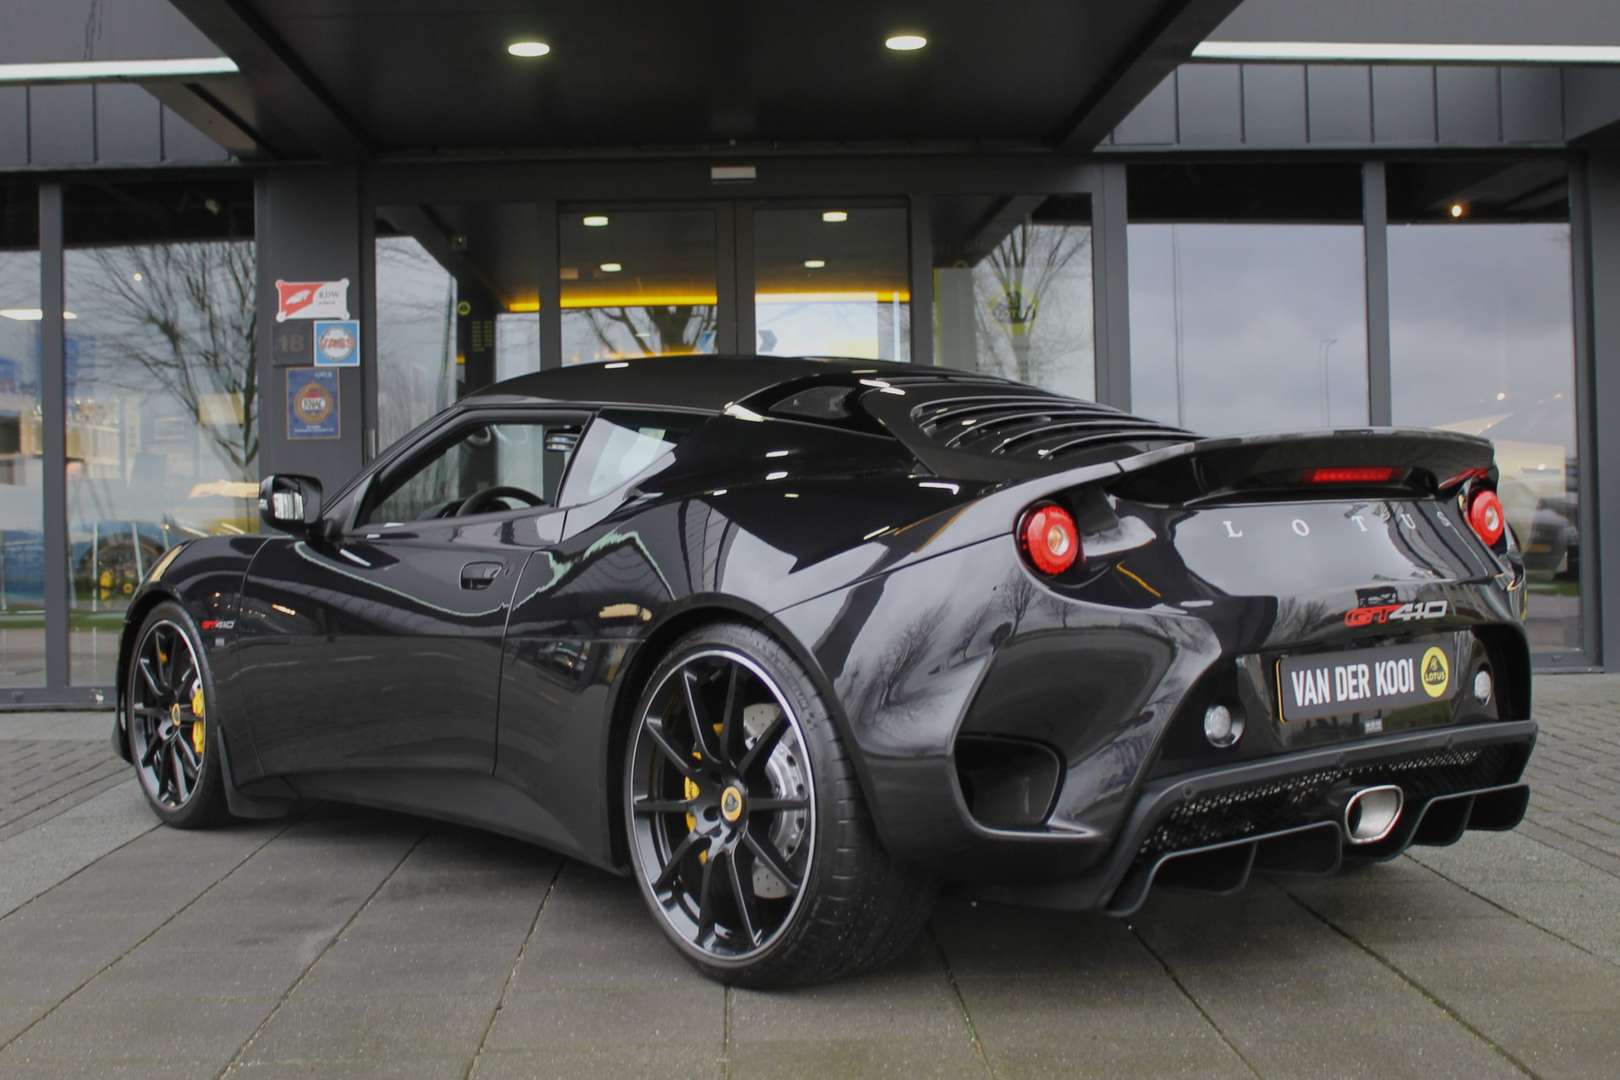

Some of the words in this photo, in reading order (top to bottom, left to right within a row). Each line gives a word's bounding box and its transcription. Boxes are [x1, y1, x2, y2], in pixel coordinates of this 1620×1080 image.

[1223, 511, 1452, 538] LOTUS
[1291, 668, 1330, 706] VAN
[1335, 664, 1371, 702] DER
[1375, 658, 1415, 696] KOOI
[1425, 672, 1446, 682] LOTUS
